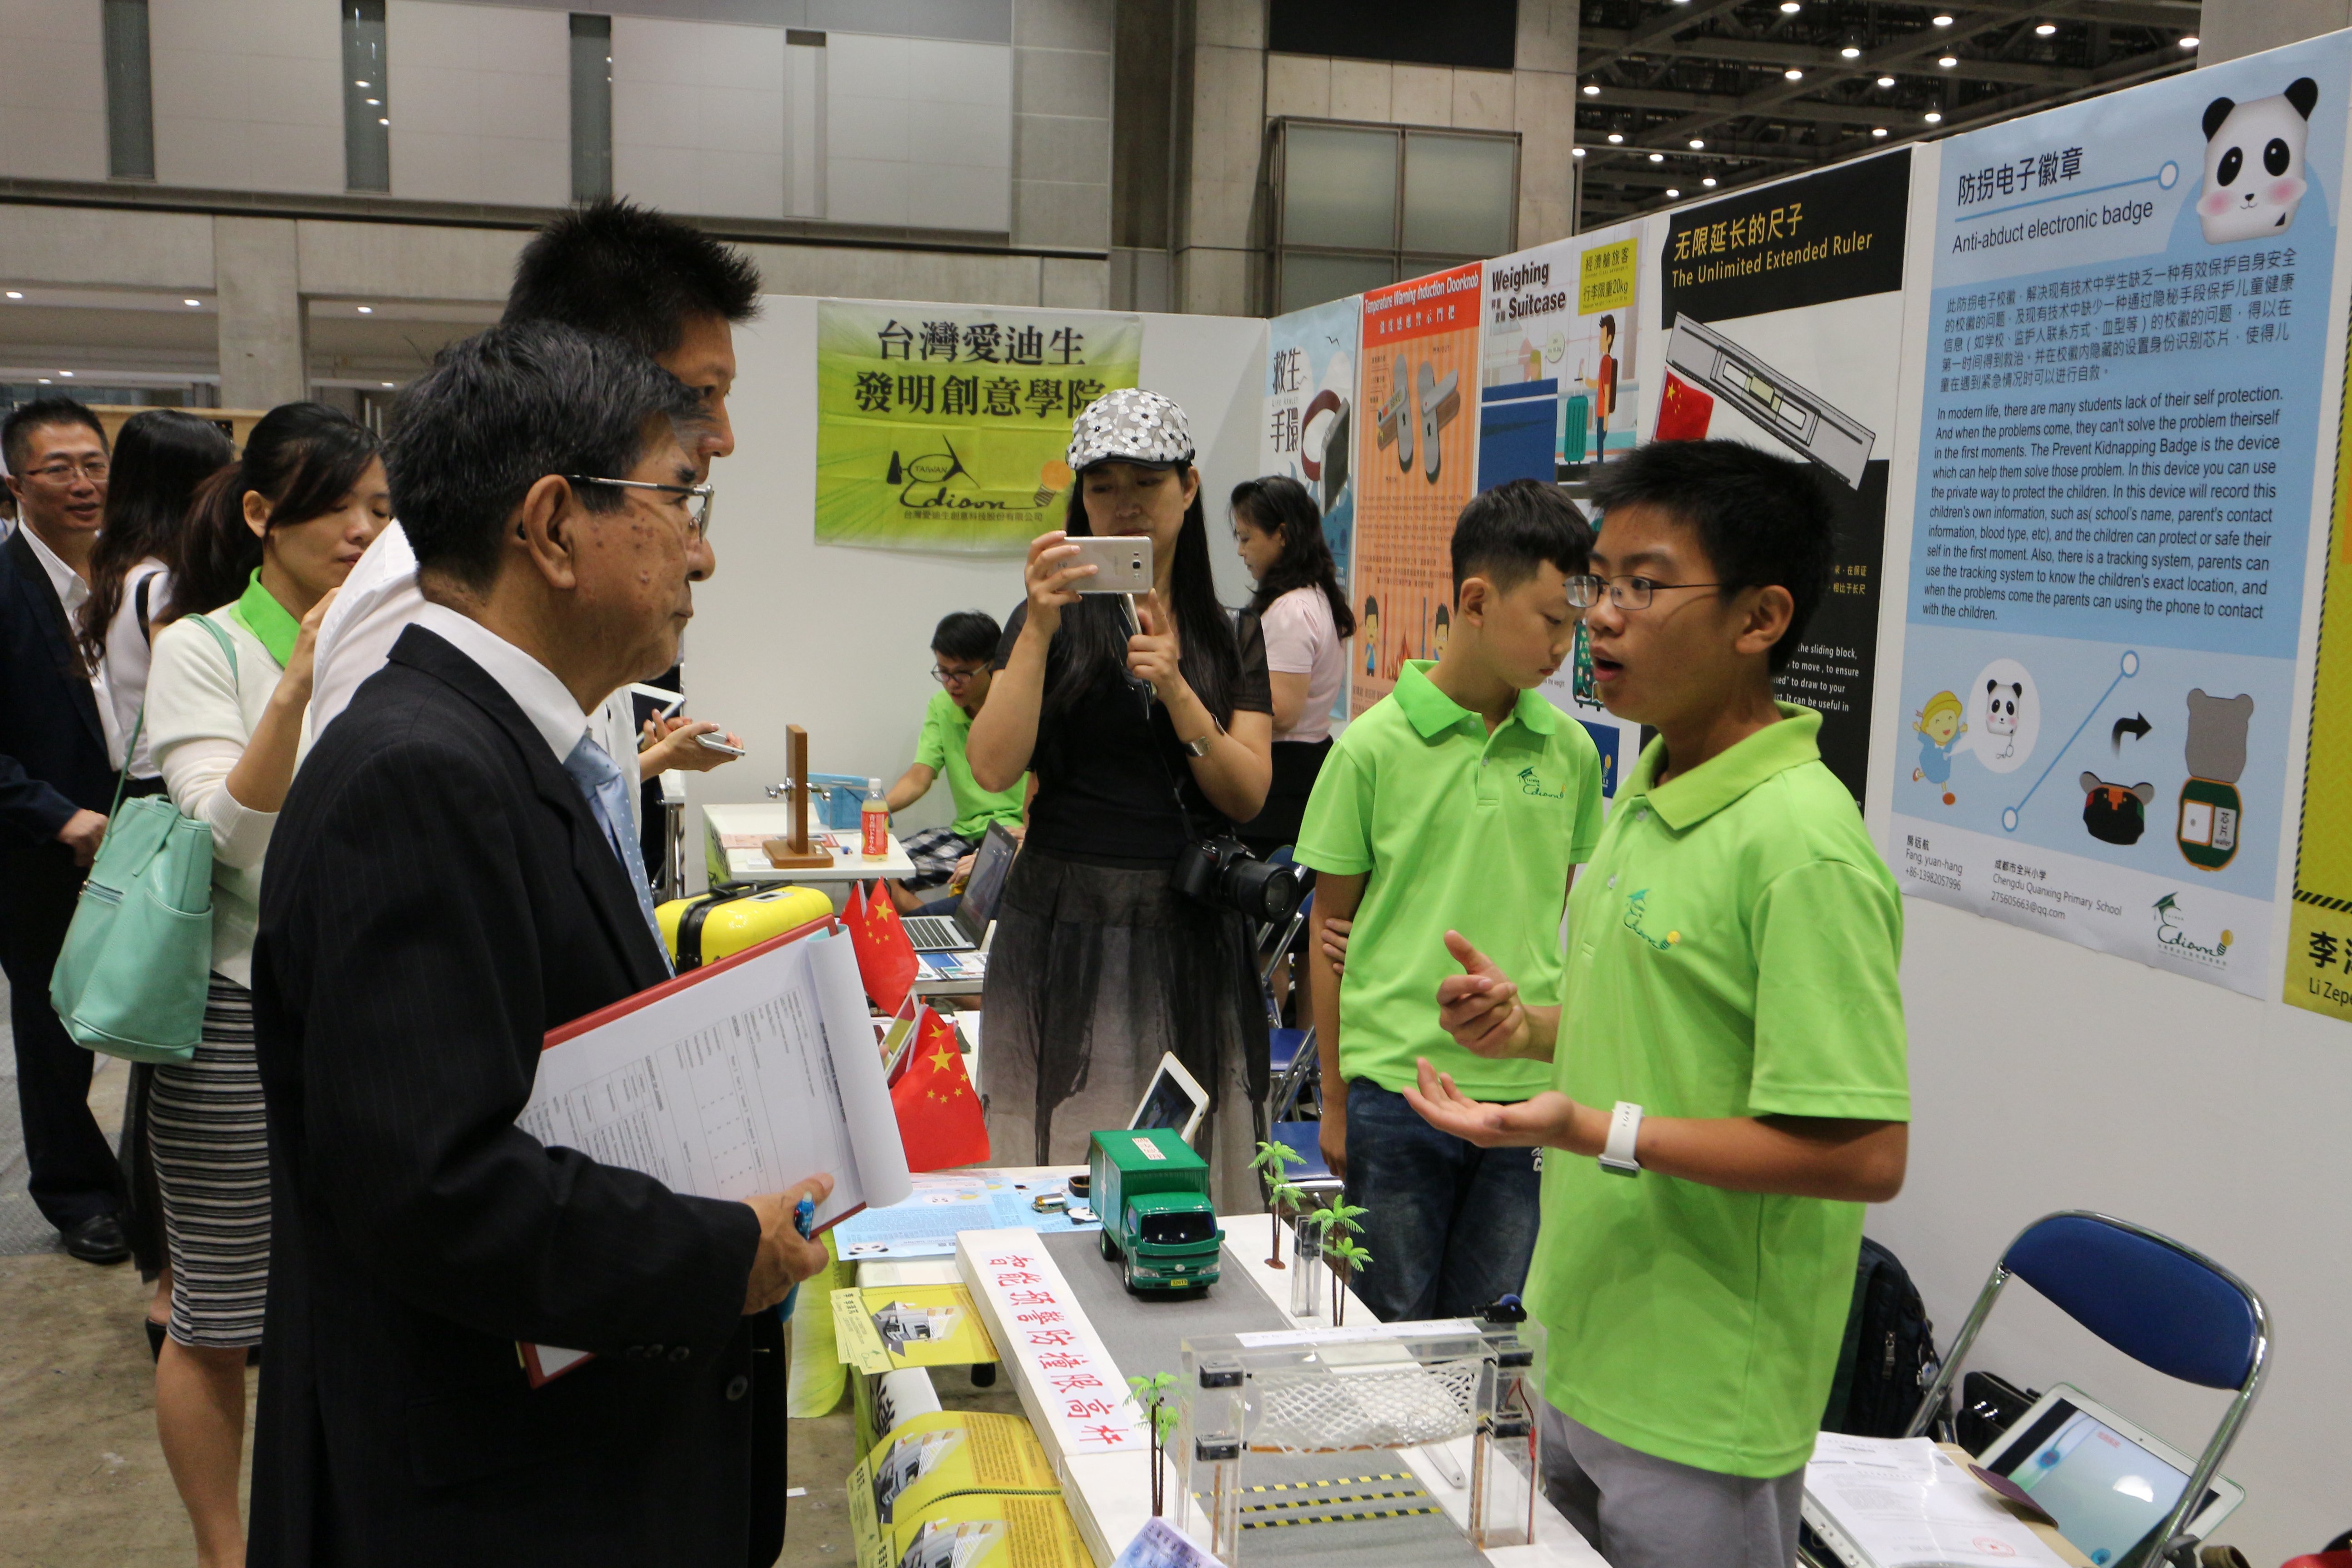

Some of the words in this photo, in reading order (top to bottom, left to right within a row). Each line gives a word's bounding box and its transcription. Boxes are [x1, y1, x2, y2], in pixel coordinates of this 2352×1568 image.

[1958, 147, 2083, 206] 防拐电子徽章
[1674, 203, 1803, 262] 无限延长的尺子
[1952, 223, 2023, 253] Anti-abduct
[2028, 209, 2097, 239] electronic
[2102, 200, 2153, 225] badge
[1672, 268, 1693, 288] The
[1698, 252, 1761, 283] Unlimited
[1766, 238, 1827, 270] Extended
[1833, 232, 1872, 255] Ruler
[1492, 261, 1549, 292] Weighing
[1365, 294, 1392, 315] Temperature
[1394, 287, 1416, 305] Warning
[1417, 279, 1445, 299] Induction
[1447, 271, 1479, 293] Doorknob
[1509, 291, 1566, 319] Suitcase
[877, 319, 1085, 364] 台灣愛迪生
[855, 372, 1106, 418] 發明創意學院
[1937, 407, 1945, 420] In
[1948, 406, 1982, 419] modern
[1985, 404, 2000, 418] life,
[2004, 403, 2028, 416] there
[2030, 404, 2046, 415] are
[2048, 402, 2076, 416] many
[2078, 397, 2122, 412] students
[2125, 394, 2146, 409] lack
[2150, 392, 2162, 407] of
[2165, 392, 2190, 407] their
[2193, 388, 2215, 405] self
[2217, 386, 2283, 407] protection.
[1936, 426, 1953, 439] And
[1955, 426, 1979, 439] when
[1982, 425, 1996, 438] the
[1999, 423, 2040, 440] problems
[2043, 424, 2072, 435] come,
[2076, 420, 2097, 436] they
[2100, 418, 2124, 432] can't
[2127, 416, 2155, 431] solve
[2159, 416, 2176, 430] the
[2180, 413, 2226, 432] problem
[2230, 409, 2280, 426] theirself
[1934, 449, 1941, 459] in
[1944, 446, 1959, 459] the
[1961, 445, 1979, 458] first
[1981, 445, 2026, 458] moments.
[2031, 443, 2049, 456] The
[2052, 442, 2092, 456] Prevent
[2095, 439, 2156, 457] Kidnapping
[2160, 437, 2197, 456] Badge
[2200, 440, 2210, 451] is
[2215, 436, 2234, 451] the
[2237, 434, 2280, 450] device
[1933, 466, 1956, 479] which
[1959, 468, 1975, 478] can
[1978, 465, 1997, 481] help
[1999, 465, 2022, 478] them
[2024, 464, 2048, 477] solve
[2052, 463, 2078, 477] those
[2081, 462, 2124, 480] problem.
[2128, 462, 2138, 475] In
[2141, 461, 2160, 475] this
[2164, 461, 2200, 475] device
[2203, 463, 2224, 478] you
[2227, 462, 2249, 475] can
[2253, 461, 2276, 474] use
[1931, 486, 1944, 498] the
[1946, 485, 1978, 501] private
[1980, 488, 1999, 501] way
[2001, 486, 2010, 498] to
[2012, 485, 2045, 501] protect
[2048, 485, 2063, 498] the
[2066, 485, 2109, 499] children.
[2113, 485, 2123, 498] In
[2127, 484, 2145, 498] this
[2149, 484, 2185, 498] device
[2189, 483, 2207, 498] will
[2210, 483, 2249, 498] record
[2254, 483, 2276, 498] this
[1930, 505, 1970, 518] children's
[1972, 508, 1991, 518] own
[1994, 505, 2047, 520] information,
[2050, 506, 2073, 519] such
[2076, 507, 2092, 523] as(
[2095, 506, 2137, 520] school's
[2140, 510, 2174, 523] name,
[2178, 506, 2223, 524] parent's
[2226, 508, 2273, 522] contact
[1922, 603, 1939, 615] with
[1941, 603, 1955, 617] the
[1958, 605, 1997, 620] children.
[1924, 583, 1945, 596] when
[1947, 584, 1961, 597] the
[1964, 586, 2005, 601] problems
[2008, 591, 2033, 602] come
[2036, 590, 2051, 603] the
[2053, 593, 2090, 607] parents
[2093, 596, 2111, 608] can
[2115, 598, 2142, 614] using
[2146, 597, 2162, 612] the
[2166, 598, 2200, 616] phone
[2204, 602, 2214, 615] to
[2218, 603, 2264, 619] contact
[1811, 643, 1833, 658] sliding
[1836, 647, 1857, 660] block,
[1792, 661, 1799, 669] to
[1802, 662, 1820, 671] move
[1826, 665, 1833, 673] to
[1835, 667, 1859, 676] ensure
[1792, 678, 1798, 686] to
[1801, 678, 1817, 690] draw
[1820, 680, 1827, 690] to
[1829, 684, 1845, 694] your
[1786, 693, 1791, 702] It
[1793, 696, 1806, 705] can
[1808, 696, 1816, 707] be
[1819, 700, 1840, 710] useful
[1842, 702, 1849, 711] in
[1906, 848, 1923, 865] Fang,
[1924, 856, 1963, 877] yuan-hang
[1905, 867, 1961, 891] +86-13982057996
[1991, 891, 2065, 919] 275605663@qq.com
[1993, 873, 2024, 890] Chengdu
[2026, 882, 2062, 902] Quanxing
[2063, 891, 2093, 910] Primary
[2096, 899, 2122, 916] School
[2309, 977, 2320, 995] Li
[990, 1255, 1128, 1444] 智能预警防撞限高杆
